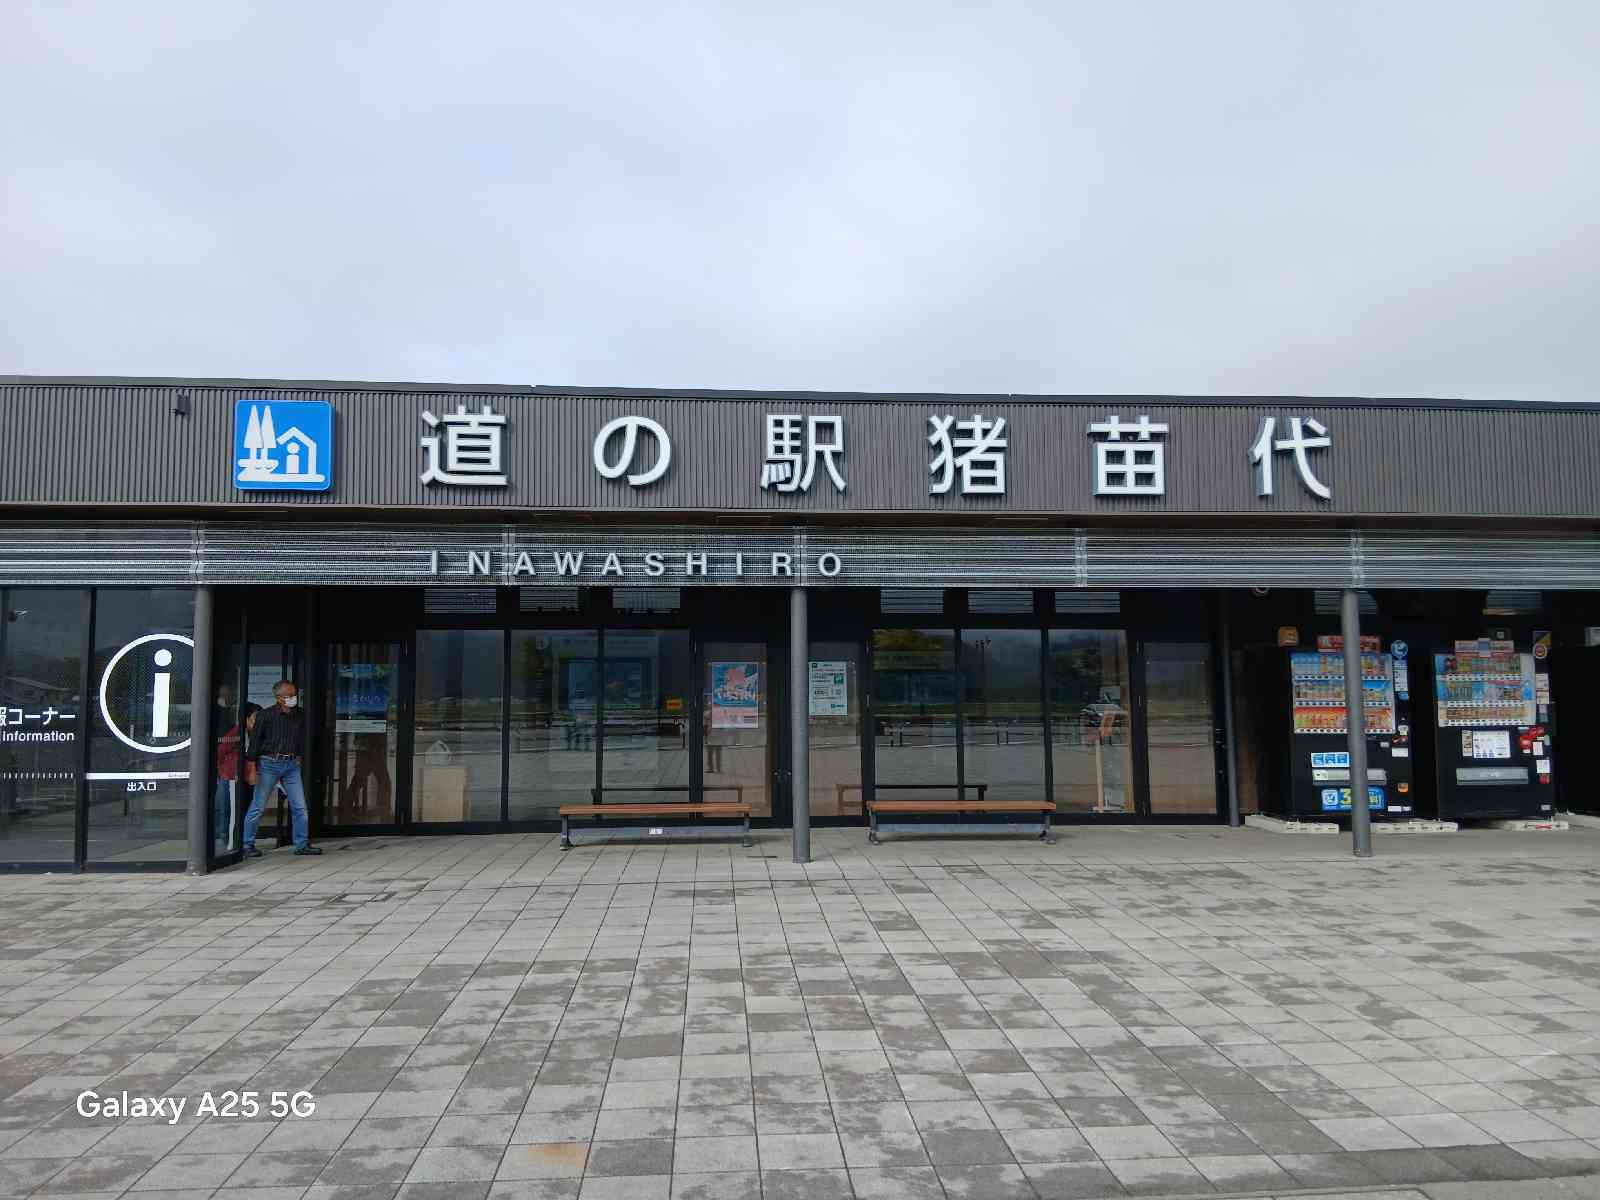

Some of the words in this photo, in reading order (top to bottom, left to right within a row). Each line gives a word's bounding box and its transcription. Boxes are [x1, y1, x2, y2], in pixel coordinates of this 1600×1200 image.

[420, 405, 1332, 500] 道の駅猪苗代
[429, 550, 843, 578] INAWASHIRO
[2, 730, 75, 742] Information
[126, 781, 158, 791] 出入口
